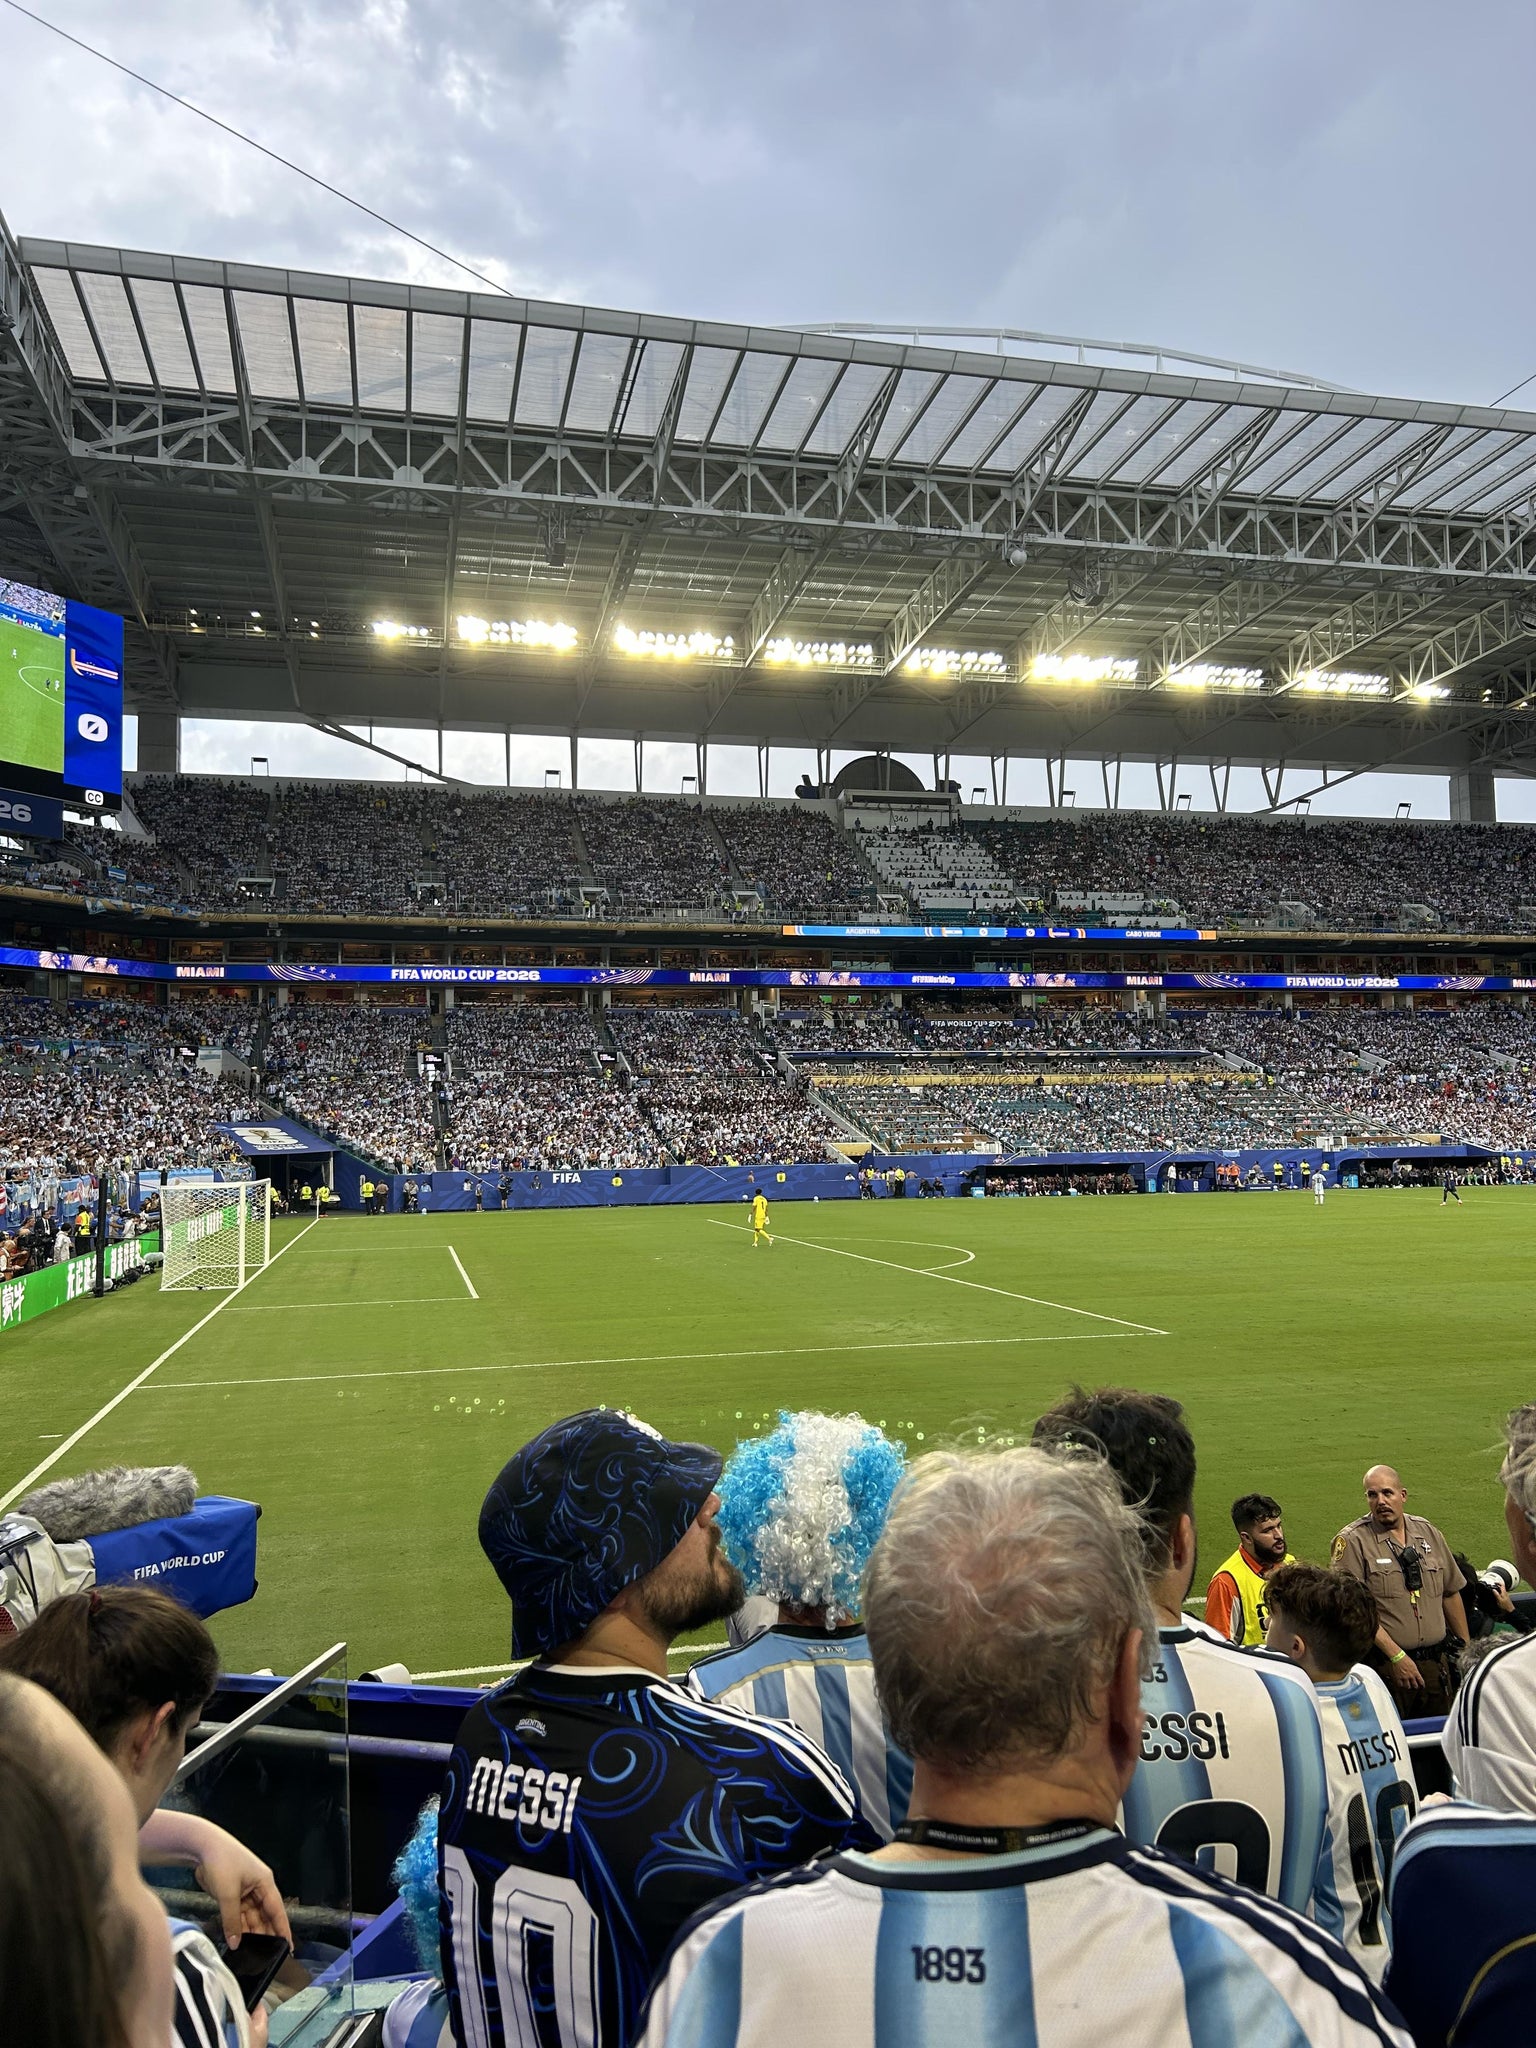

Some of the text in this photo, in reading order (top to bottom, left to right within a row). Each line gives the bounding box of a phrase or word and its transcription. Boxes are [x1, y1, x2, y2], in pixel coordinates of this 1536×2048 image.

[87, 792, 102, 803] CC
[894, 815, 909, 823] 346
[1125, 930, 1142, 938] CABO
[176, 966, 225, 977] MIAMI
[391, 968, 541, 981] FIFA WORLD CUP 2026
[689, 972, 730, 983] MIAMI
[1126, 976, 1163, 985] MIAMI
[1286, 977, 1400, 987] FIFA WORLD CUP 2026
[552, 1172, 582, 1183] FIFA
[2, 1282, 25, 1326] 蒙牛
[134, 1563, 160, 1580] FIFA
[160, 1555, 200, 1573] WORLD
[1139, 1711, 1230, 1761] ESSI
[1337, 1729, 1402, 1776] MESSI
[466, 1756, 583, 1834] MESSI
[911, 1945, 987, 1984] 1893
